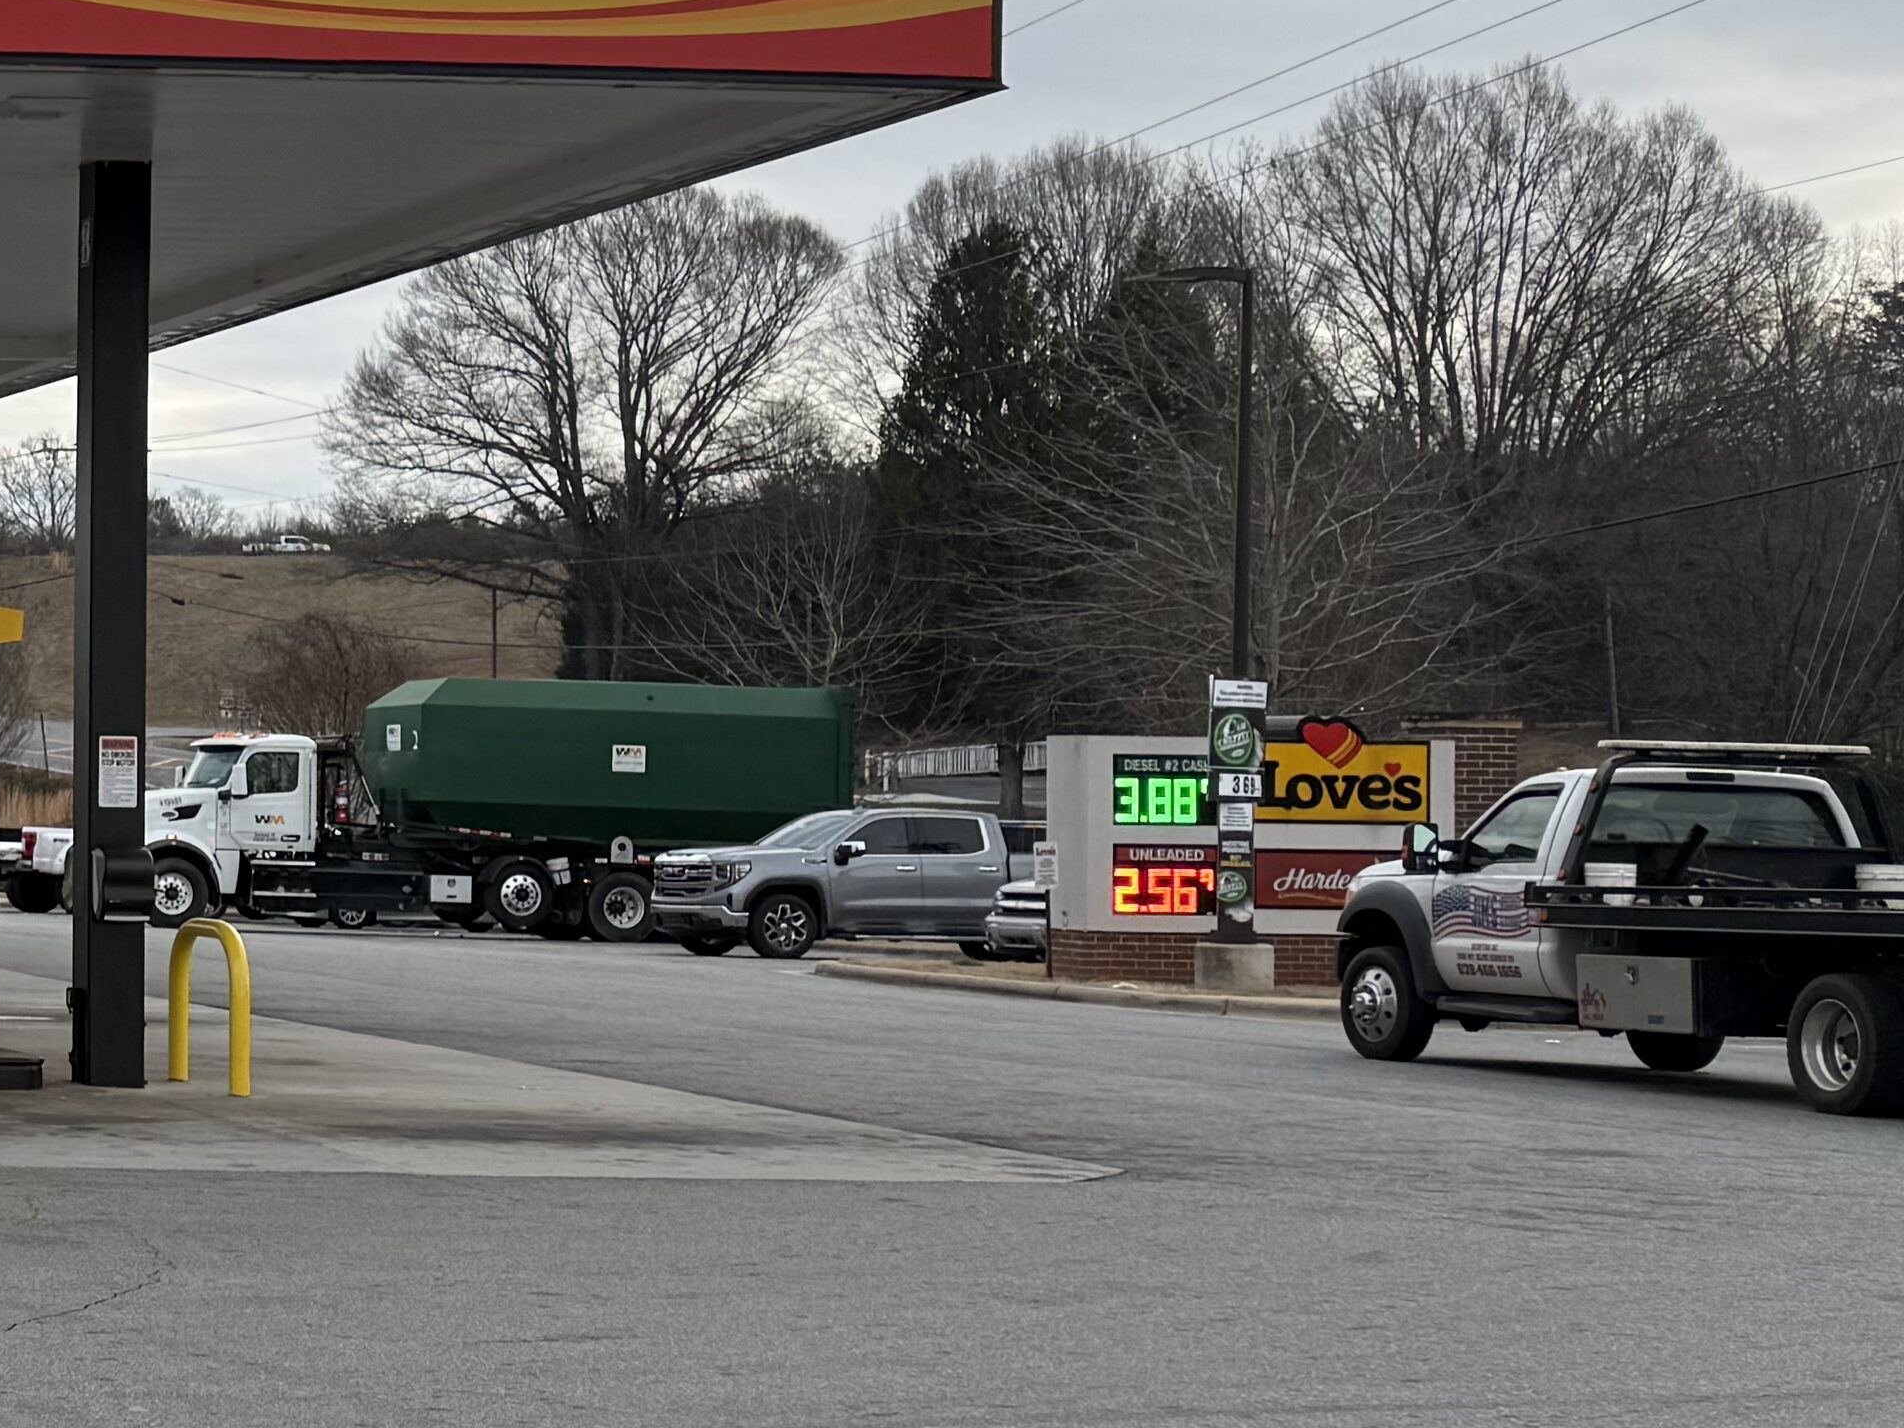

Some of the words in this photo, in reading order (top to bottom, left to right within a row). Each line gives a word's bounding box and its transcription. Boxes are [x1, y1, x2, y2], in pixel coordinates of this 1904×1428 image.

[1123, 759, 1161, 771] DIESEL
[1164, 760, 1179, 771] #2
[254, 813, 286, 825] WM
[1129, 848, 1205, 862] UNLEADED
